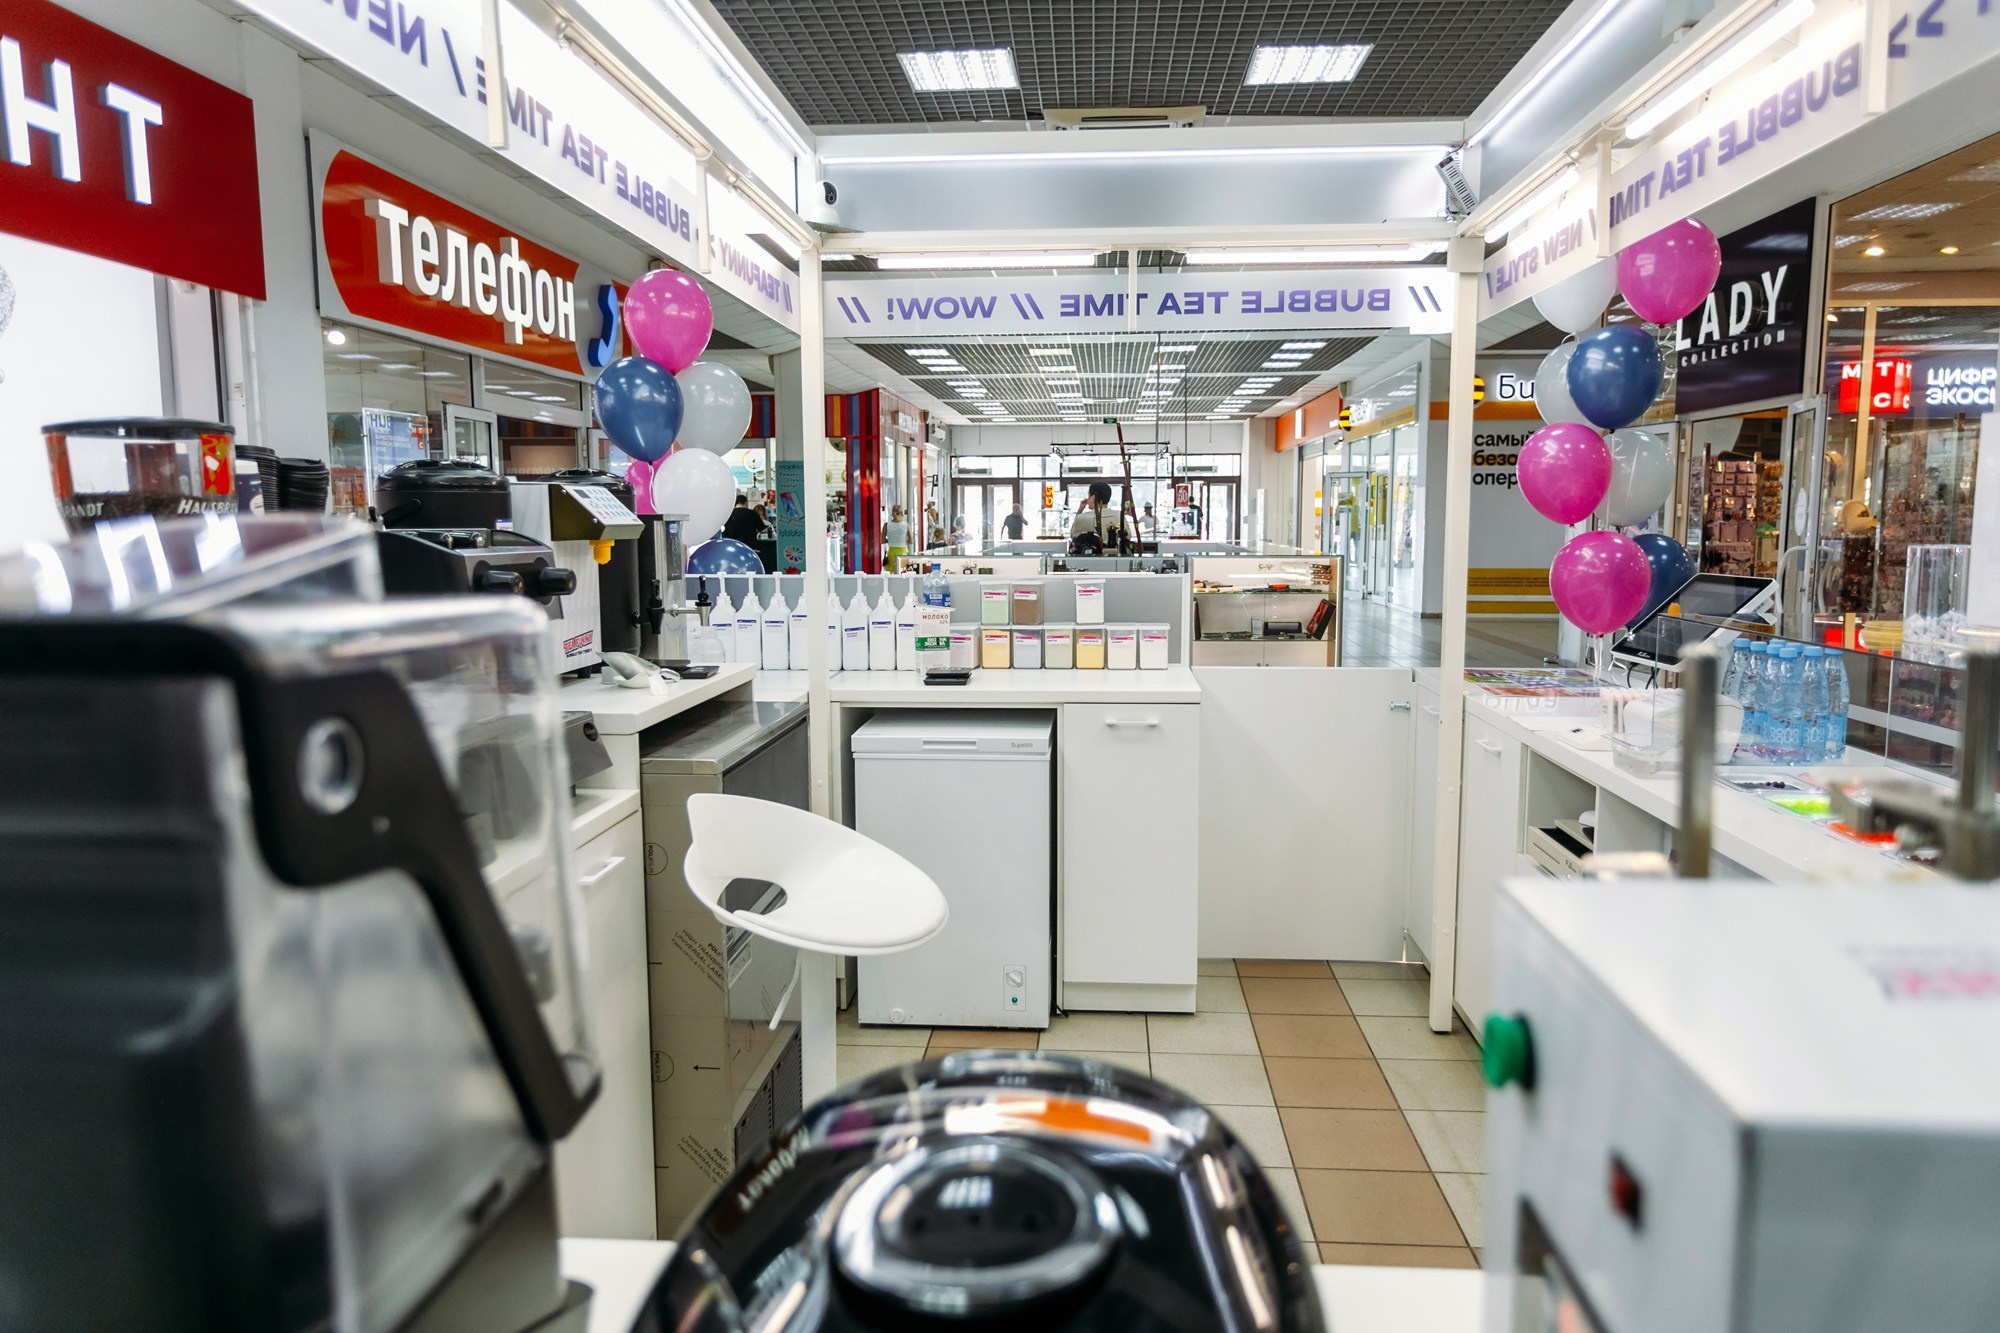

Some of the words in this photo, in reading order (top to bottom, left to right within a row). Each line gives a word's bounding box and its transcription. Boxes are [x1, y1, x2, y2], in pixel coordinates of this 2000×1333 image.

[370, 199, 576, 345] телефон
[1675, 264, 1788, 352] LADY
[1681, 329, 1785, 367] COLLECTION
[1927, 367, 1997, 387] ЦИФР
[1473, 449, 1518, 466] безо
[1472, 472, 1518, 489] опер
[675, 932, 707, 965] UNIVERSAL
[682, 929, 698, 945] HIGH
[681, 1136, 713, 1170] UNIVERSAL
